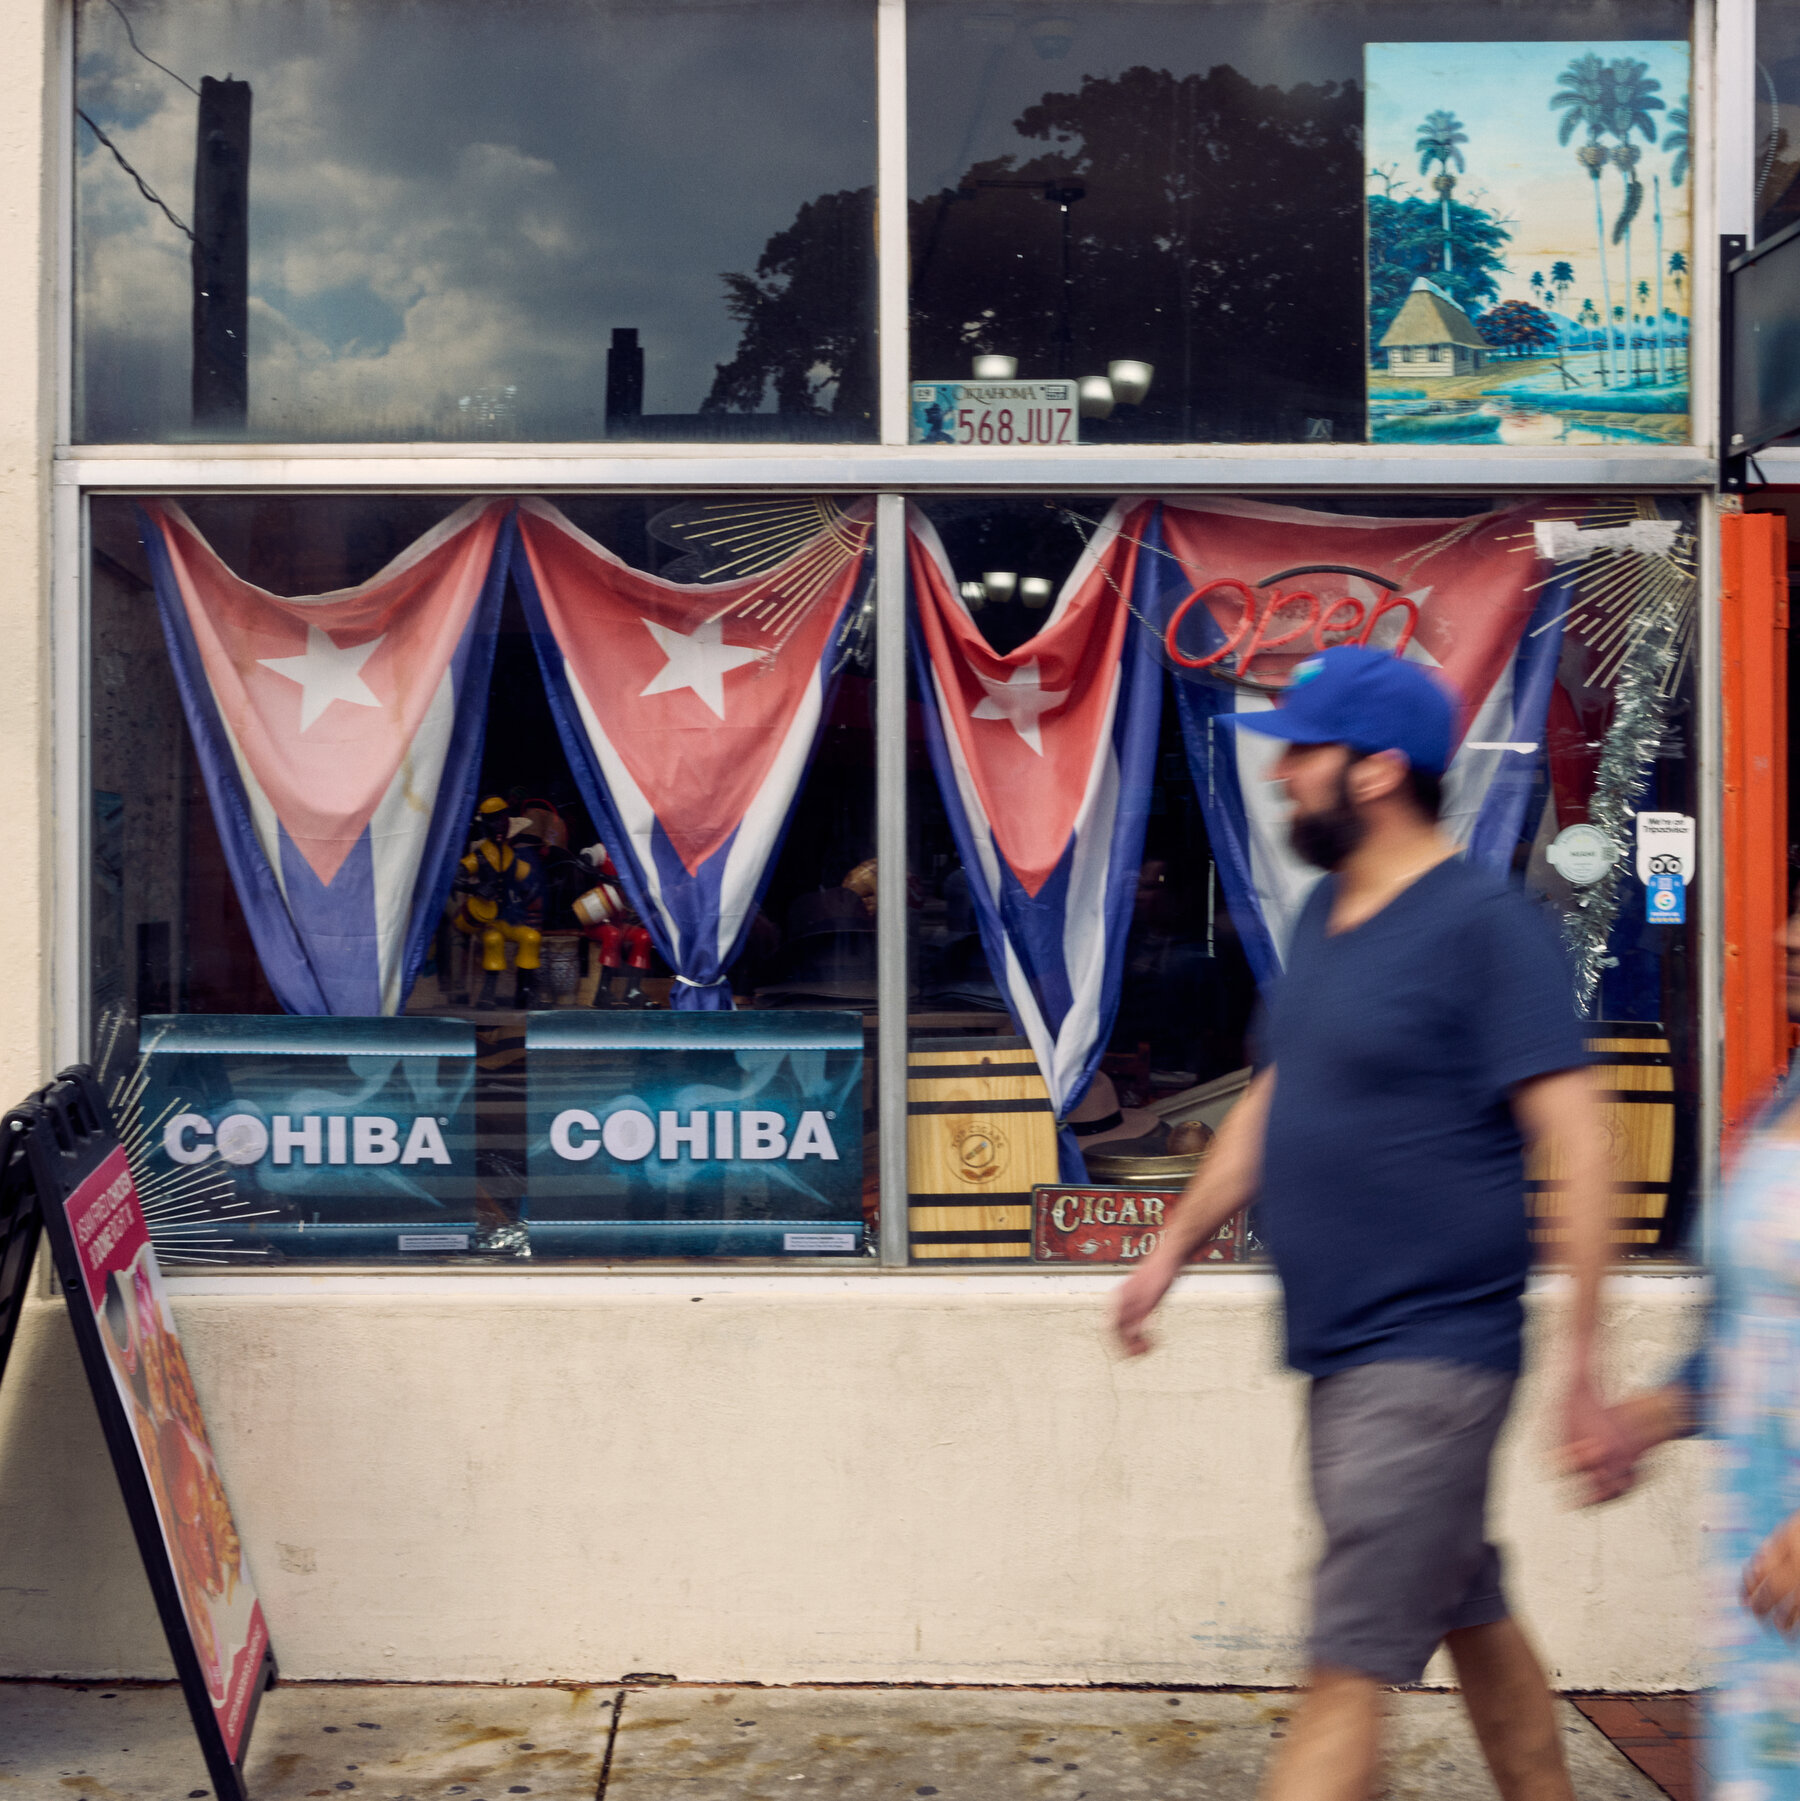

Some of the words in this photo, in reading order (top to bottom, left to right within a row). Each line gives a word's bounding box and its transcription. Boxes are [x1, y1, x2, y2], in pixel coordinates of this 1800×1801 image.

[953, 385, 1037, 405] OKLAHOMA
[1165, 577, 1419, 677] Open
[164, 1113, 452, 1166] COHIBA
[550, 1108, 840, 1162] COHIBA
